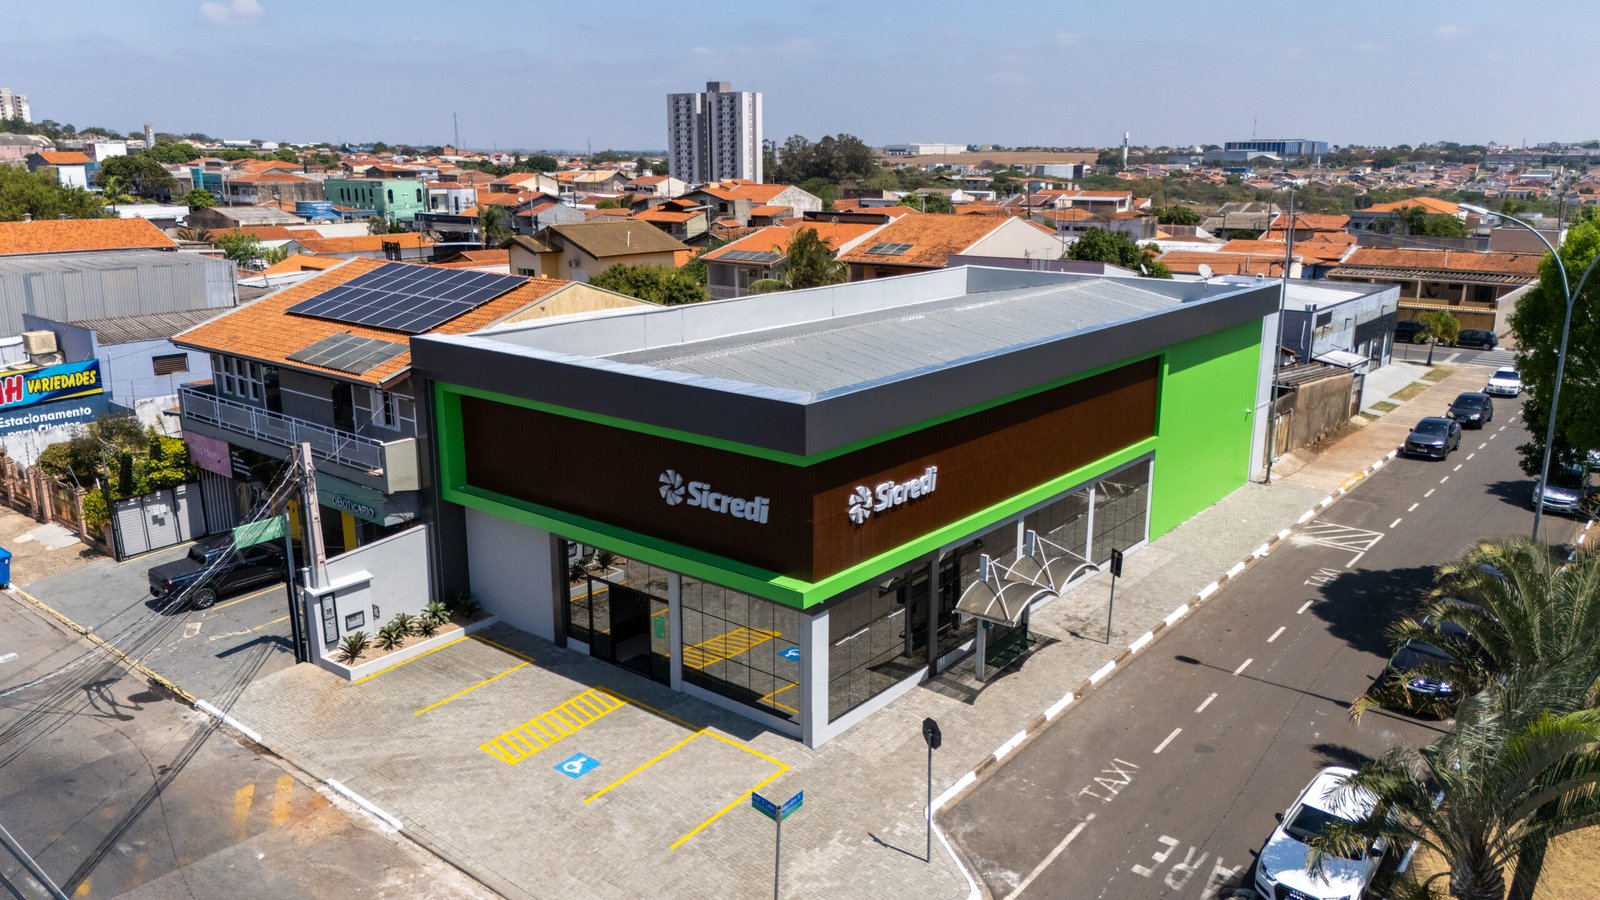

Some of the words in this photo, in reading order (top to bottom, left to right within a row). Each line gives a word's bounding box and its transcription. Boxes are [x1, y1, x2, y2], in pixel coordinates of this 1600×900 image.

[0, 375, 23, 405] H
[27, 370, 97, 394] VARIEDADES
[0, 407, 92, 429] Estacionamento
[687, 481, 770, 524] Sicredi
[873, 466, 938, 512] Sicredi
[1303, 567, 1343, 588] TAXI
[1078, 758, 1142, 802] TAXI
